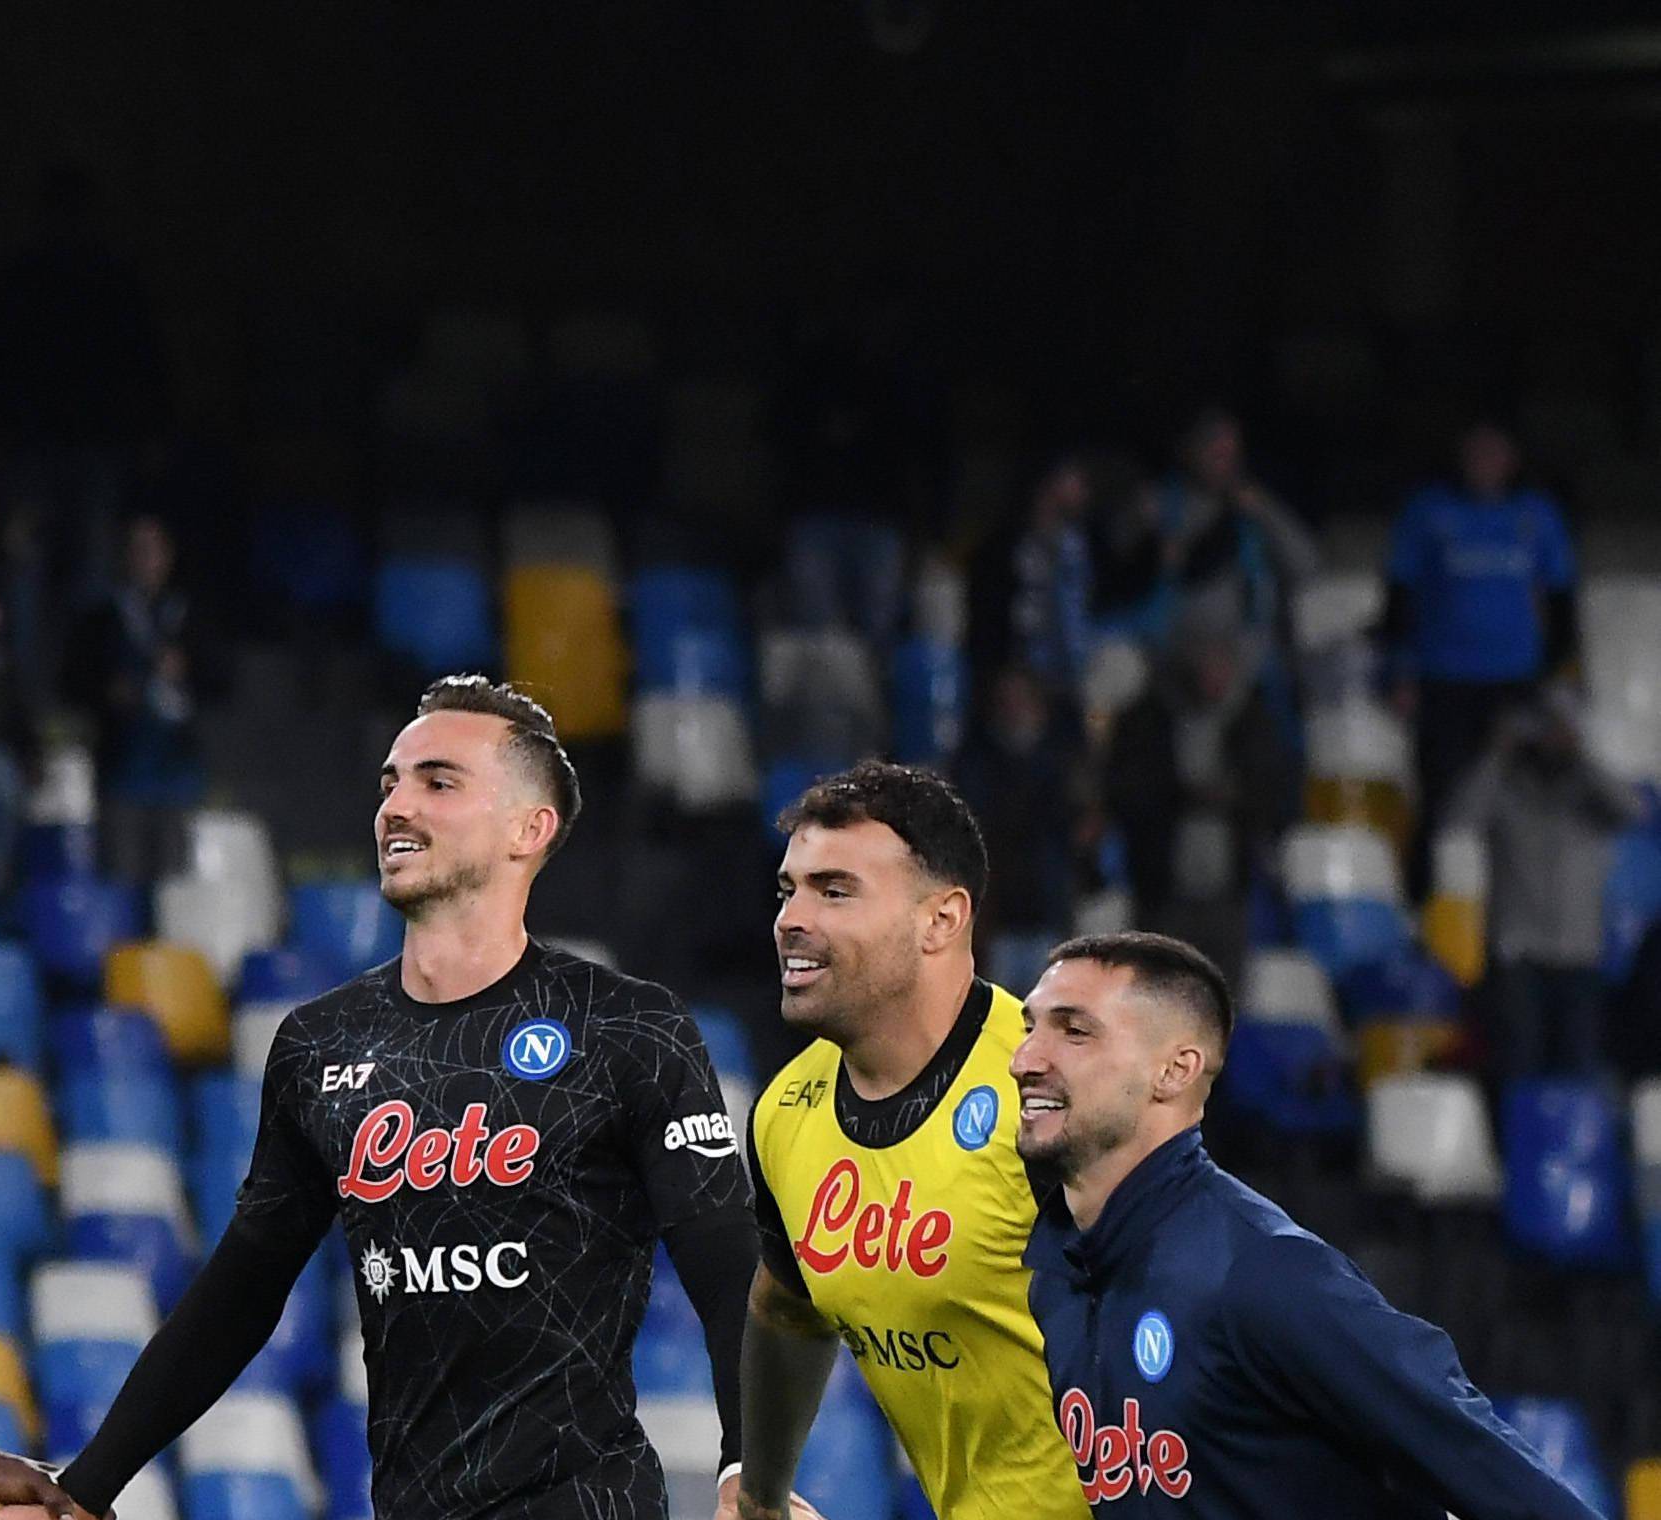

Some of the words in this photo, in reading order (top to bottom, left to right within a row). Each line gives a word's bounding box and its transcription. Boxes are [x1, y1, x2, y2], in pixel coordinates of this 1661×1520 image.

[520, 1033, 555, 1064] N
[321, 1062, 376, 1092] EA7
[778, 1080, 828, 1108] EA7
[966, 1102, 988, 1134] N
[337, 1100, 540, 1203] Lete
[794, 1158, 952, 1279] Lete
[400, 1241, 530, 1293] MSC
[864, 1326, 960, 1371] MSC
[1143, 1328, 1162, 1365] N
[1060, 1387, 1192, 1505] Lete
